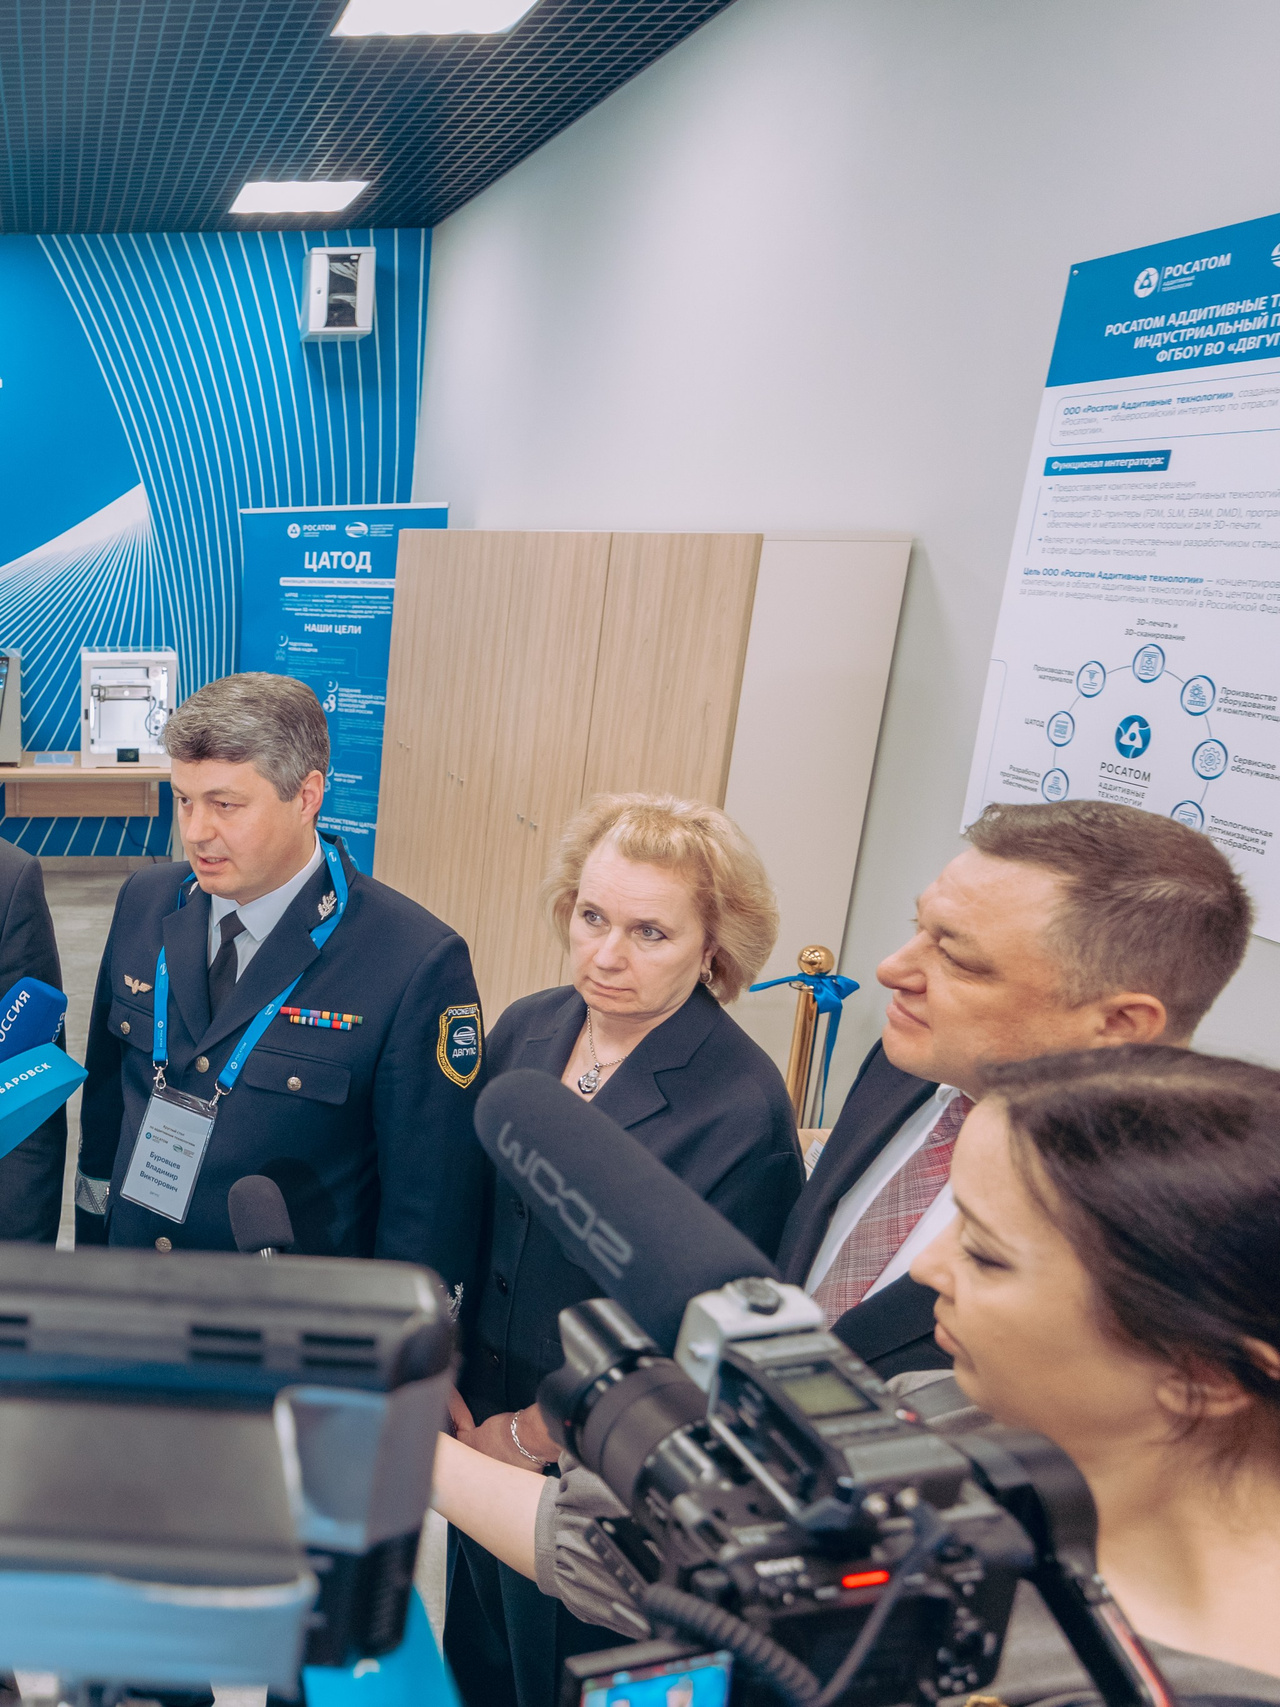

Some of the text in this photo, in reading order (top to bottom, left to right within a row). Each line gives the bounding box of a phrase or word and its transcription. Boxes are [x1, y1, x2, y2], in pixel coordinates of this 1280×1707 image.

[1163, 253, 1232, 279] РОСАТОМ
[1105, 315, 1166, 337] РОСАТОМ
[1166, 296, 1269, 327] АДДИТИВНЫЕ
[1133, 312, 1269, 349] ИНДУСТРИАЛЬНЫЙ
[1156, 344, 1204, 363] ФГБОУ
[1203, 341, 1225, 356] ВО
[1063, 407, 1080, 416] ООО
[1082, 403, 1118, 414] «Росатом
[1120, 397, 1172, 410] Аддитивные
[1177, 405, 1224, 417] интегратор
[1240, 400, 1278, 412] отрасли
[1051, 458, 1102, 470] Функционал
[1176, 491, 1225, 500] аддитивных
[1183, 537, 1250, 549] разработчиком
[304, 551, 372, 573] ЦАТОД
[1023, 567, 1040, 577] Цель
[1042, 568, 1058, 578] ООО
[1060, 569, 1095, 579] «Росатом
[1098, 571, 1146, 582] Аддитивные
[1148, 573, 1204, 585] технологии»
[1206, 600, 1256, 613] Российской
[304, 623, 362, 635] НАШИ ЦЕЛИ
[1136, 618, 1172, 630] 3D-печать
[1124, 629, 1185, 641] 3D-сканирование
[1034, 664, 1074, 676] Производство
[1221, 687, 1278, 702] Производство
[1218, 696, 1276, 712] оборудования
[1009, 764, 1040, 778] Разработка
[1233, 755, 1276, 770] Сервисное
[1100, 762, 1151, 782] РОСАТОМ
[1098, 781, 1146, 799] АДДИТИВНЫЕ
[1098, 790, 1142, 807] ТЕХНОЛОГИИ
[1208, 826, 1260, 844] оптимизация
[1210, 815, 1273, 838] Топологическая
[1210, 835, 1265, 855] остобработка
[452, 1046, 477, 1059] ДВГУПС
[149, 1151, 181, 1170] Буровцев
[145, 1161, 179, 1181] Владимир
[139, 1170, 178, 1192] Викторович
